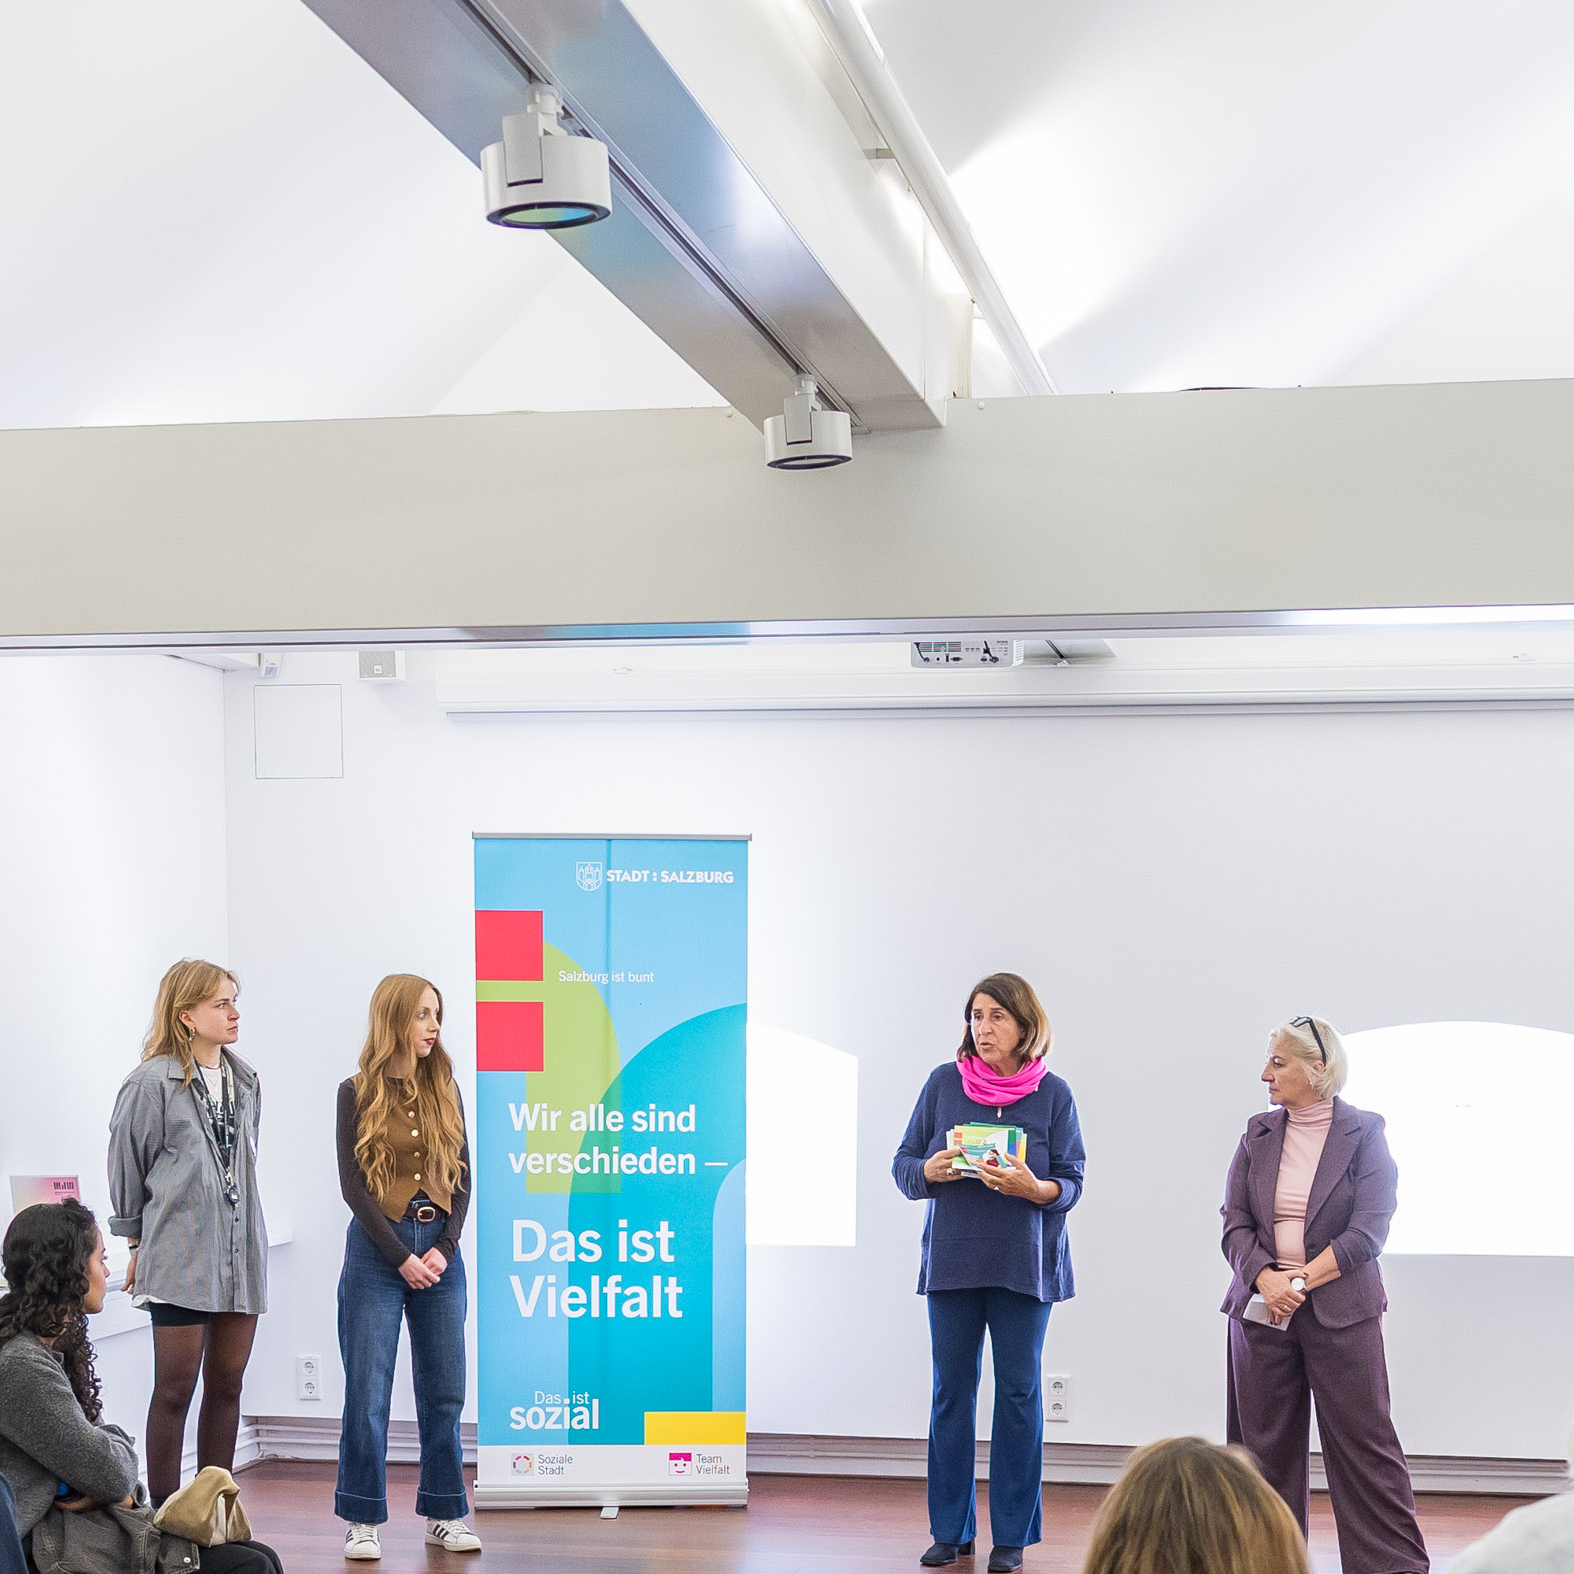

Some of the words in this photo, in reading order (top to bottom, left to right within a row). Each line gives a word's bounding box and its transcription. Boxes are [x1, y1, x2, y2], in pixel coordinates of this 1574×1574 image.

[606, 869, 649, 883] STADT
[660, 870, 735, 884] SALZBURG
[558, 970, 609, 984] Salzburg
[611, 971, 625, 983] ist
[628, 971, 655, 983] bunt
[508, 1103, 563, 1132] Wir
[569, 1103, 624, 1133] alle
[631, 1104, 696, 1132] sind
[508, 1146, 696, 1175] verschieden
[512, 1219, 602, 1263] Das
[618, 1219, 675, 1263] ist
[509, 1274, 683, 1318] Vielfalt
[534, 1390, 562, 1405] Das
[572, 1390, 590, 1405] ist
[509, 1398, 599, 1430] sozial
[537, 1453, 573, 1465] Soziale
[696, 1453, 722, 1464] Team
[537, 1465, 565, 1476] Stadt
[696, 1465, 730, 1475] Vielfalt
